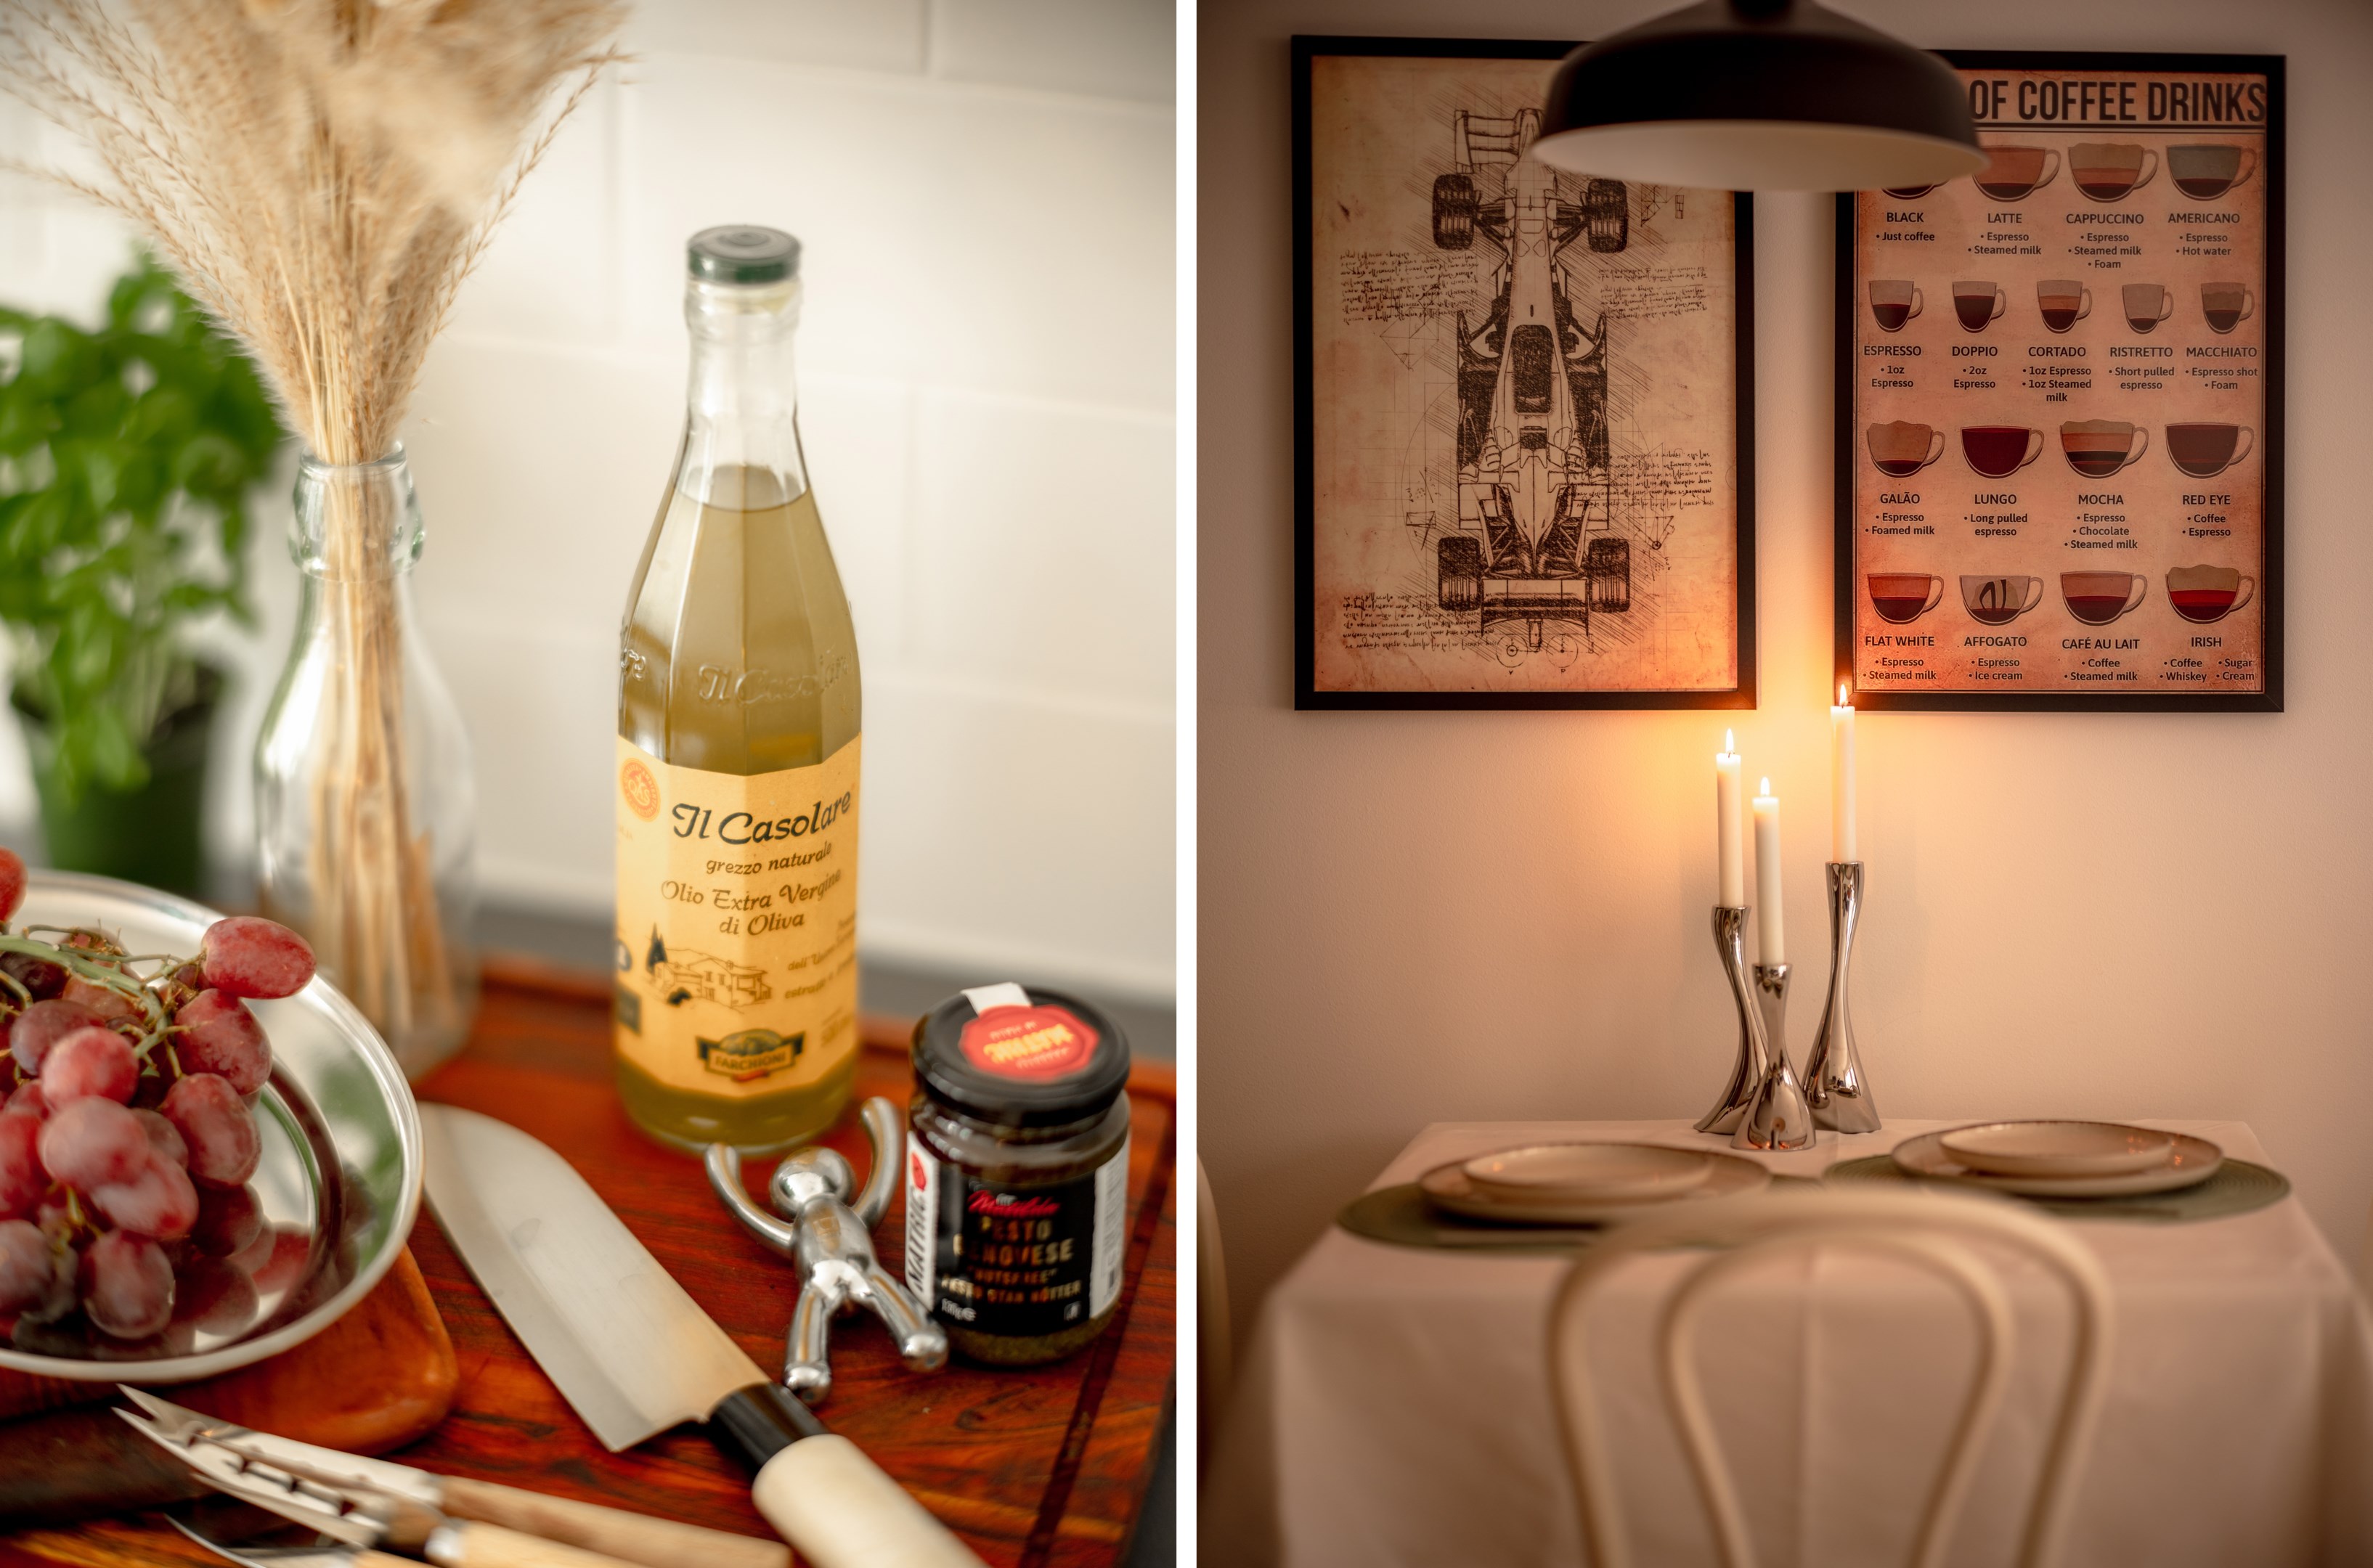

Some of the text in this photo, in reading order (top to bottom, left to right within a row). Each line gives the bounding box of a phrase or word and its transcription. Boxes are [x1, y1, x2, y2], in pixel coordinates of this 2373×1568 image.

[1969, 79, 2266, 122] OF COFFEE DRINKS
[1887, 213, 1924, 222] BLACK
[1988, 213, 2022, 223] LATTE
[2067, 214, 2144, 224] CAPPUCCINO
[2168, 213, 2239, 223] AMERICANO
[1987, 232, 2029, 242] Espresso
[2088, 233, 2129, 243] Espresso
[2186, 234, 2228, 244] Espresso
[1974, 245, 2016, 254] Steamed
[2075, 246, 2141, 255] Steamed milk
[1865, 346, 1921, 356] ESPRESSO
[1953, 346, 1998, 356] DOPPIO
[2029, 347, 2085, 356] CORTADO
[2110, 347, 2173, 356] RISTRETTO
[2187, 348, 2257, 357] MACCHIATO
[1969, 366, 1987, 375] 2oz
[2050, 367, 2091, 377] Espresso
[2115, 367, 2174, 377] Short pulled
[2192, 367, 2258, 377] Espresso shot
[1872, 379, 1913, 389] Espresso
[1954, 380, 1995, 390] Espresso
[2047, 393, 2067, 401] milk
[1881, 492, 1920, 503] GALÃO
[1975, 494, 2016, 504] LUNGO
[2079, 495, 2123, 505] MOCHA
[2183, 495, 2230, 505] RED EYE
[1883, 513, 1924, 523] Espresso
[1971, 513, 2027, 524] Long pulled
[2084, 514, 2125, 524] Espresso
[2194, 514, 2226, 523] Coffee
[1872, 526, 1934, 534] Foamed milk
[2080, 526, 2129, 535] Chocolate
[2189, 528, 2231, 538] Espresso
[2071, 539, 2137, 548] Steamed milk
[1865, 637, 1934, 646] FLAT WHITE
[1964, 637, 2027, 646] AFFOGATO
[2062, 637, 2140, 649] CAFÉ AU LAIT
[2191, 637, 2221, 647] IRISH
[1882, 658, 1924, 668] Espresso
[1979, 658, 2019, 669] Espresso
[2088, 658, 2120, 667] Coffee
[2170, 658, 2202, 667] Coffee
[2225, 658, 2252, 669] Sugar
[1870, 671, 1912, 680] Steamed
[2071, 671, 2137, 680] Steamed milk
[2166, 671, 2207, 682] Whiskey
[2223, 672, 2254, 681] Cream
[672, 803, 712, 838] Il
[717, 791, 851, 845] Casolare
[706, 840, 832, 875] grezzo naturale
[662, 869, 842, 911] Olio Extra Vergine
[719, 912, 805, 936] di Oliva
[715, 1052, 786, 1071] FARCHIONI
